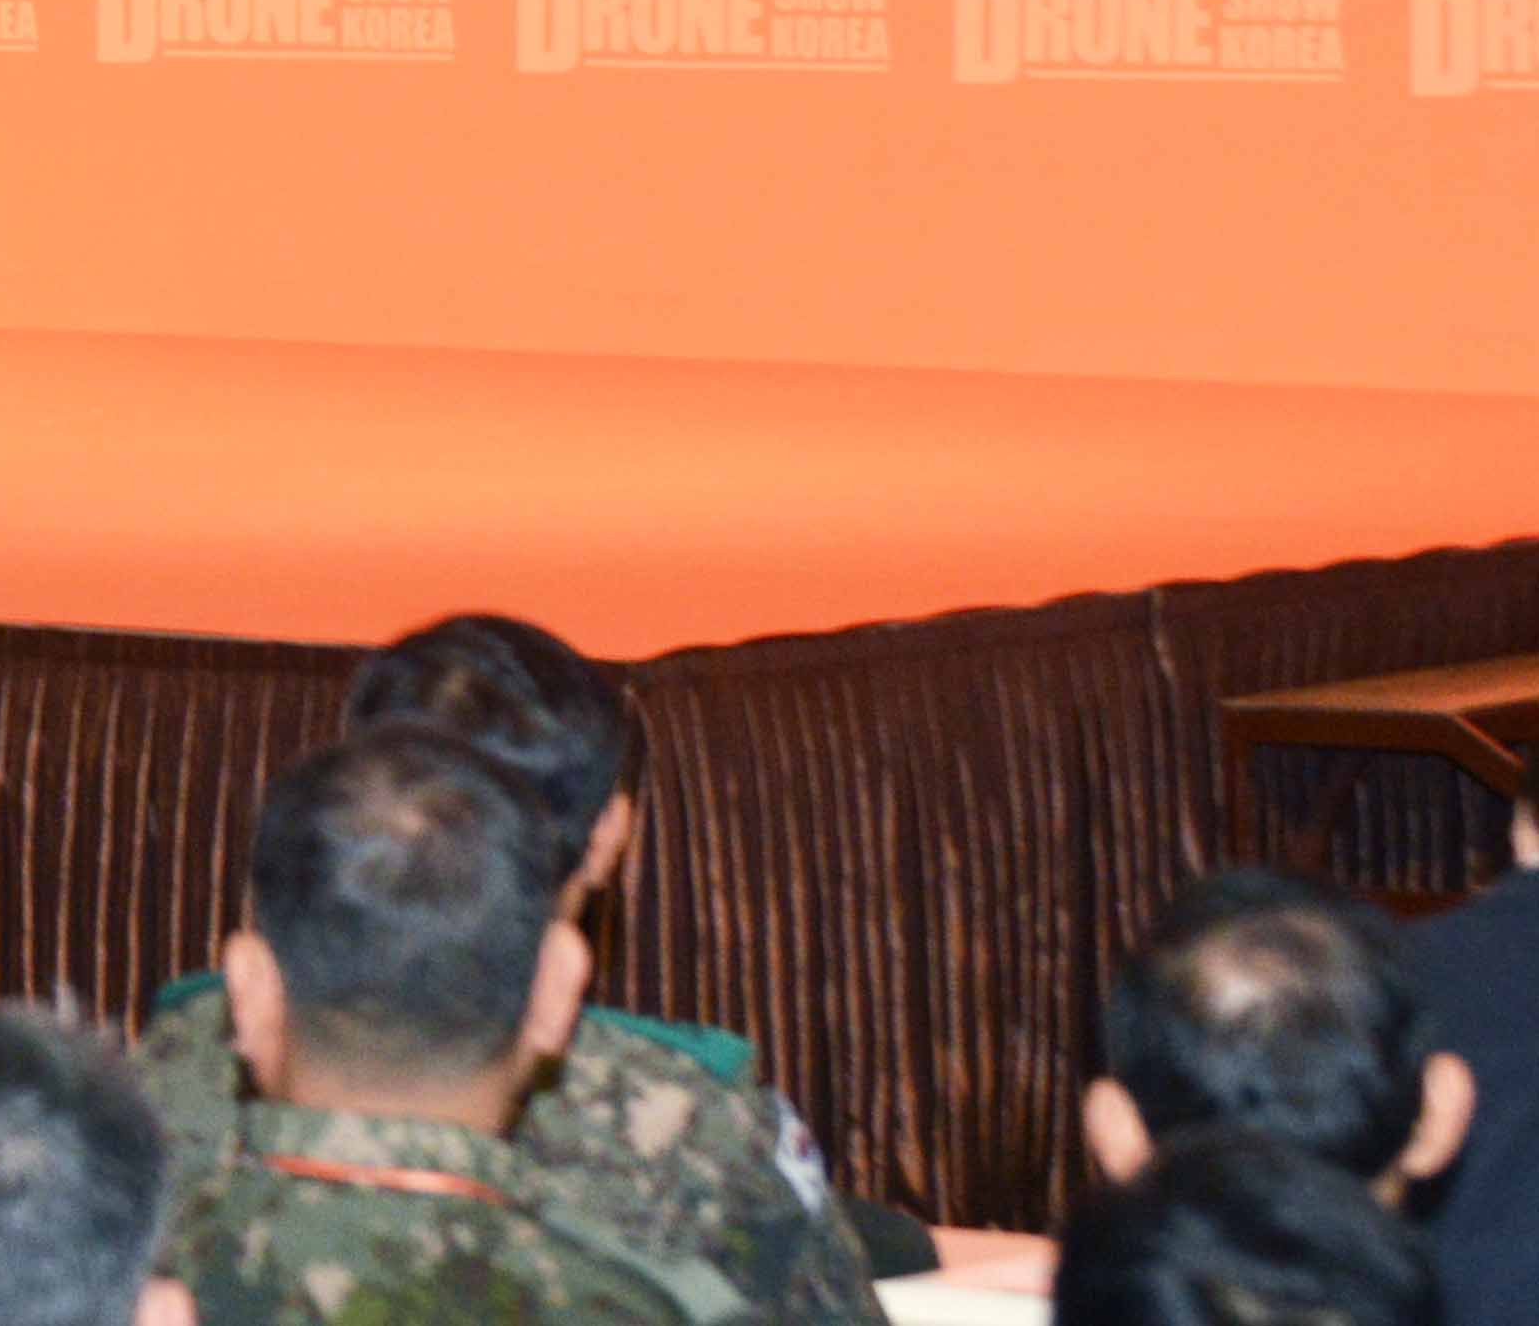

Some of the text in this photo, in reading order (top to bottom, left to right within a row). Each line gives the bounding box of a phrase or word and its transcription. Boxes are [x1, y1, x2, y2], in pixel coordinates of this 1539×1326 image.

[342, 7, 455, 51] KOREA
[772, 17, 888, 59] KOREA
[1221, 25, 1343, 68] KOREA
